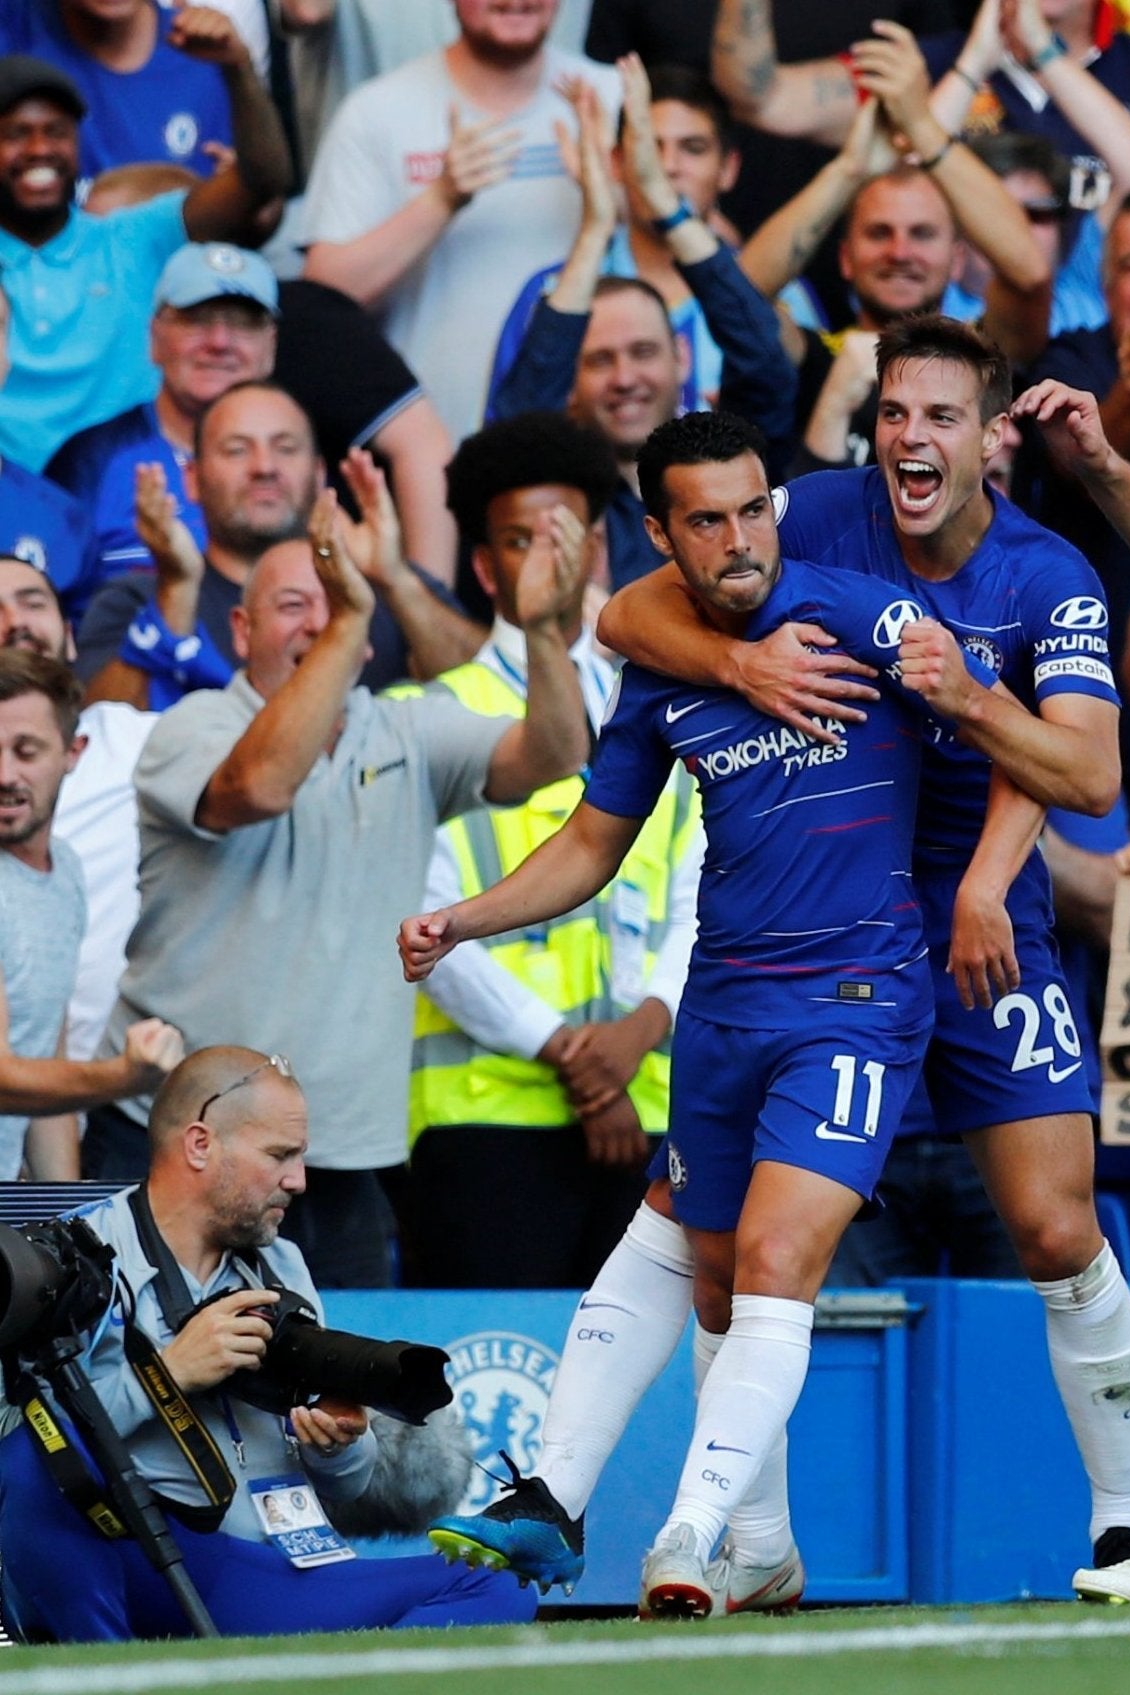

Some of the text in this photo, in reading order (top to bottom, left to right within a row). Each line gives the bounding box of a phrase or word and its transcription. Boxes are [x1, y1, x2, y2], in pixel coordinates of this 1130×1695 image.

[783, 739, 849, 777] TYRES
[993, 983, 1081, 1072] 28
[831, 1055, 885, 1138] 11
[577, 1328, 615, 1344] CFC
[145, 1365, 170, 1399] Nikon
[446, 1340, 558, 1393] HELSEA
[32, 1410, 53, 1437] Nikon
[701, 1469, 731, 1491] CFC
